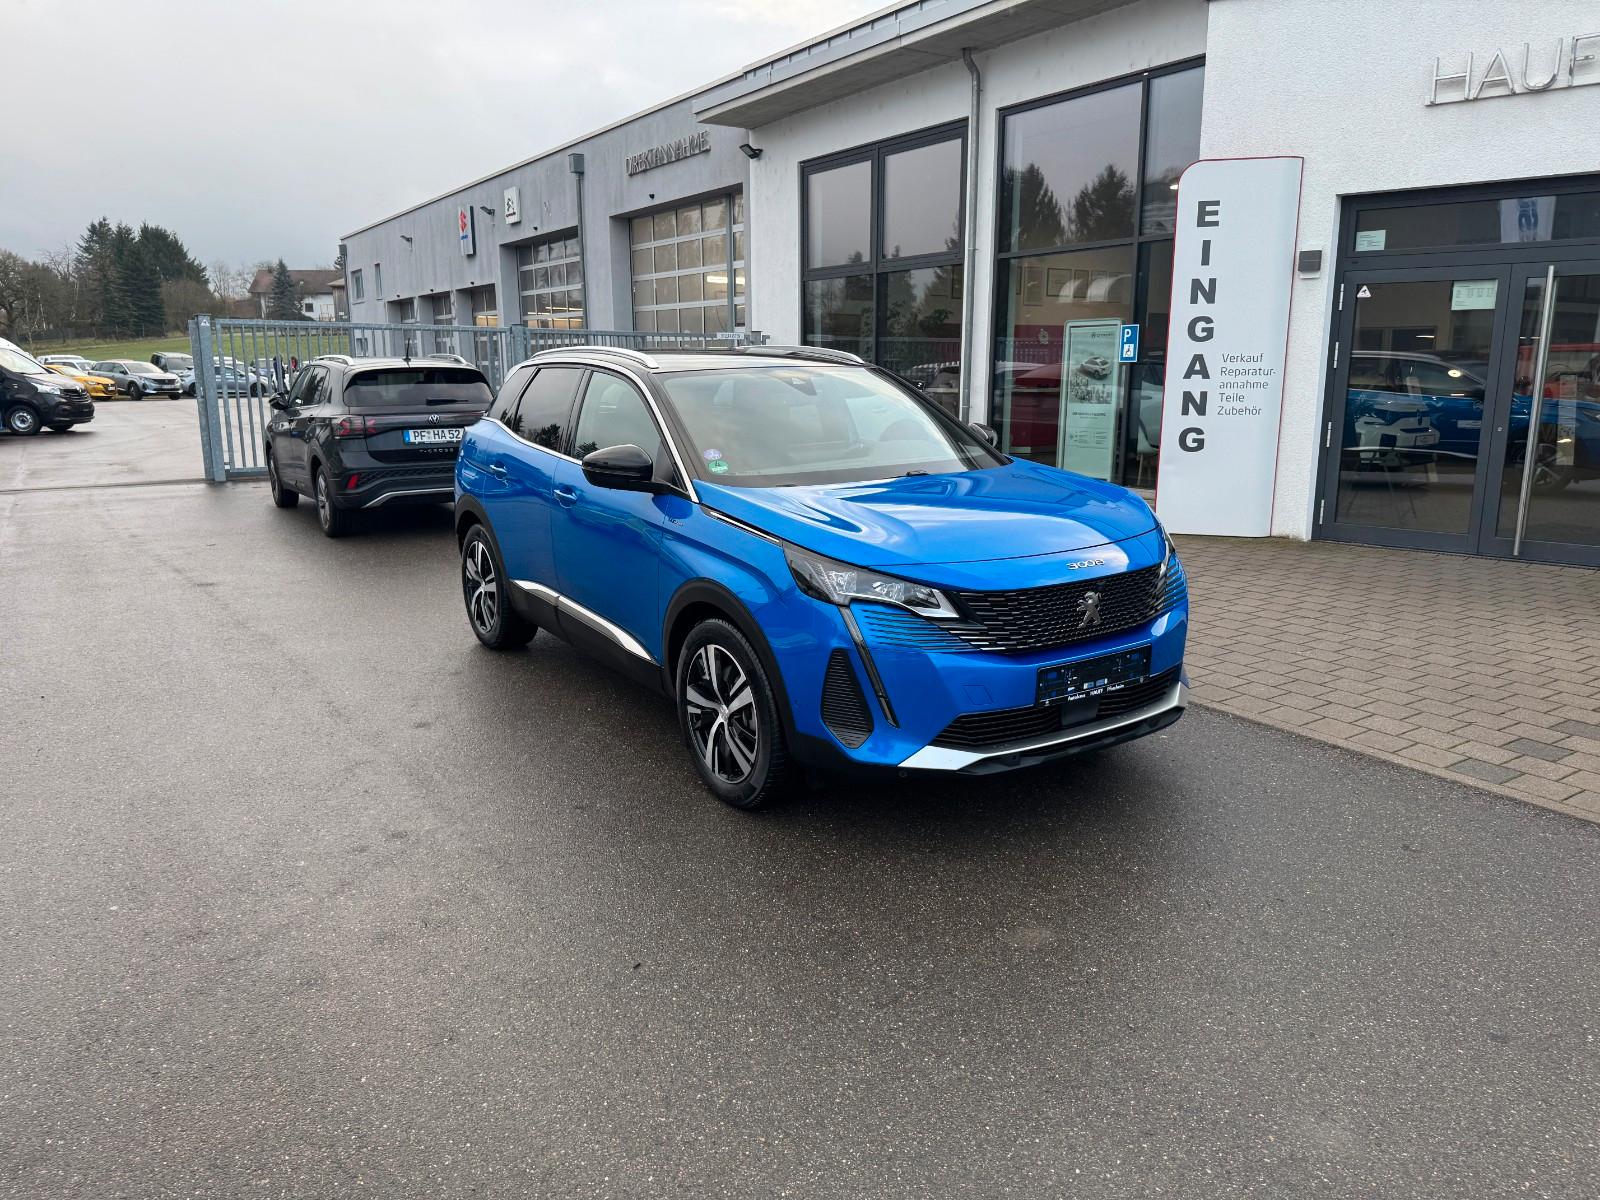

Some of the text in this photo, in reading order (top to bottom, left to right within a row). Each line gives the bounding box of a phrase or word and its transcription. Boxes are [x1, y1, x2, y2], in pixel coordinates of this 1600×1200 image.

[626, 129, 710, 175] DIREKTANNAHME
[1178, 199, 1221, 453] EINGANG
[1123, 328, 1132, 343] P
[1221, 352, 1265, 363] Verkauf
[1220, 366, 1277, 379] Reparatur-
[1219, 379, 1269, 389] annahme
[1218, 392, 1245, 403] Teile
[1217, 405, 1263, 416] Zubehör
[413, 430, 426, 440] PF
